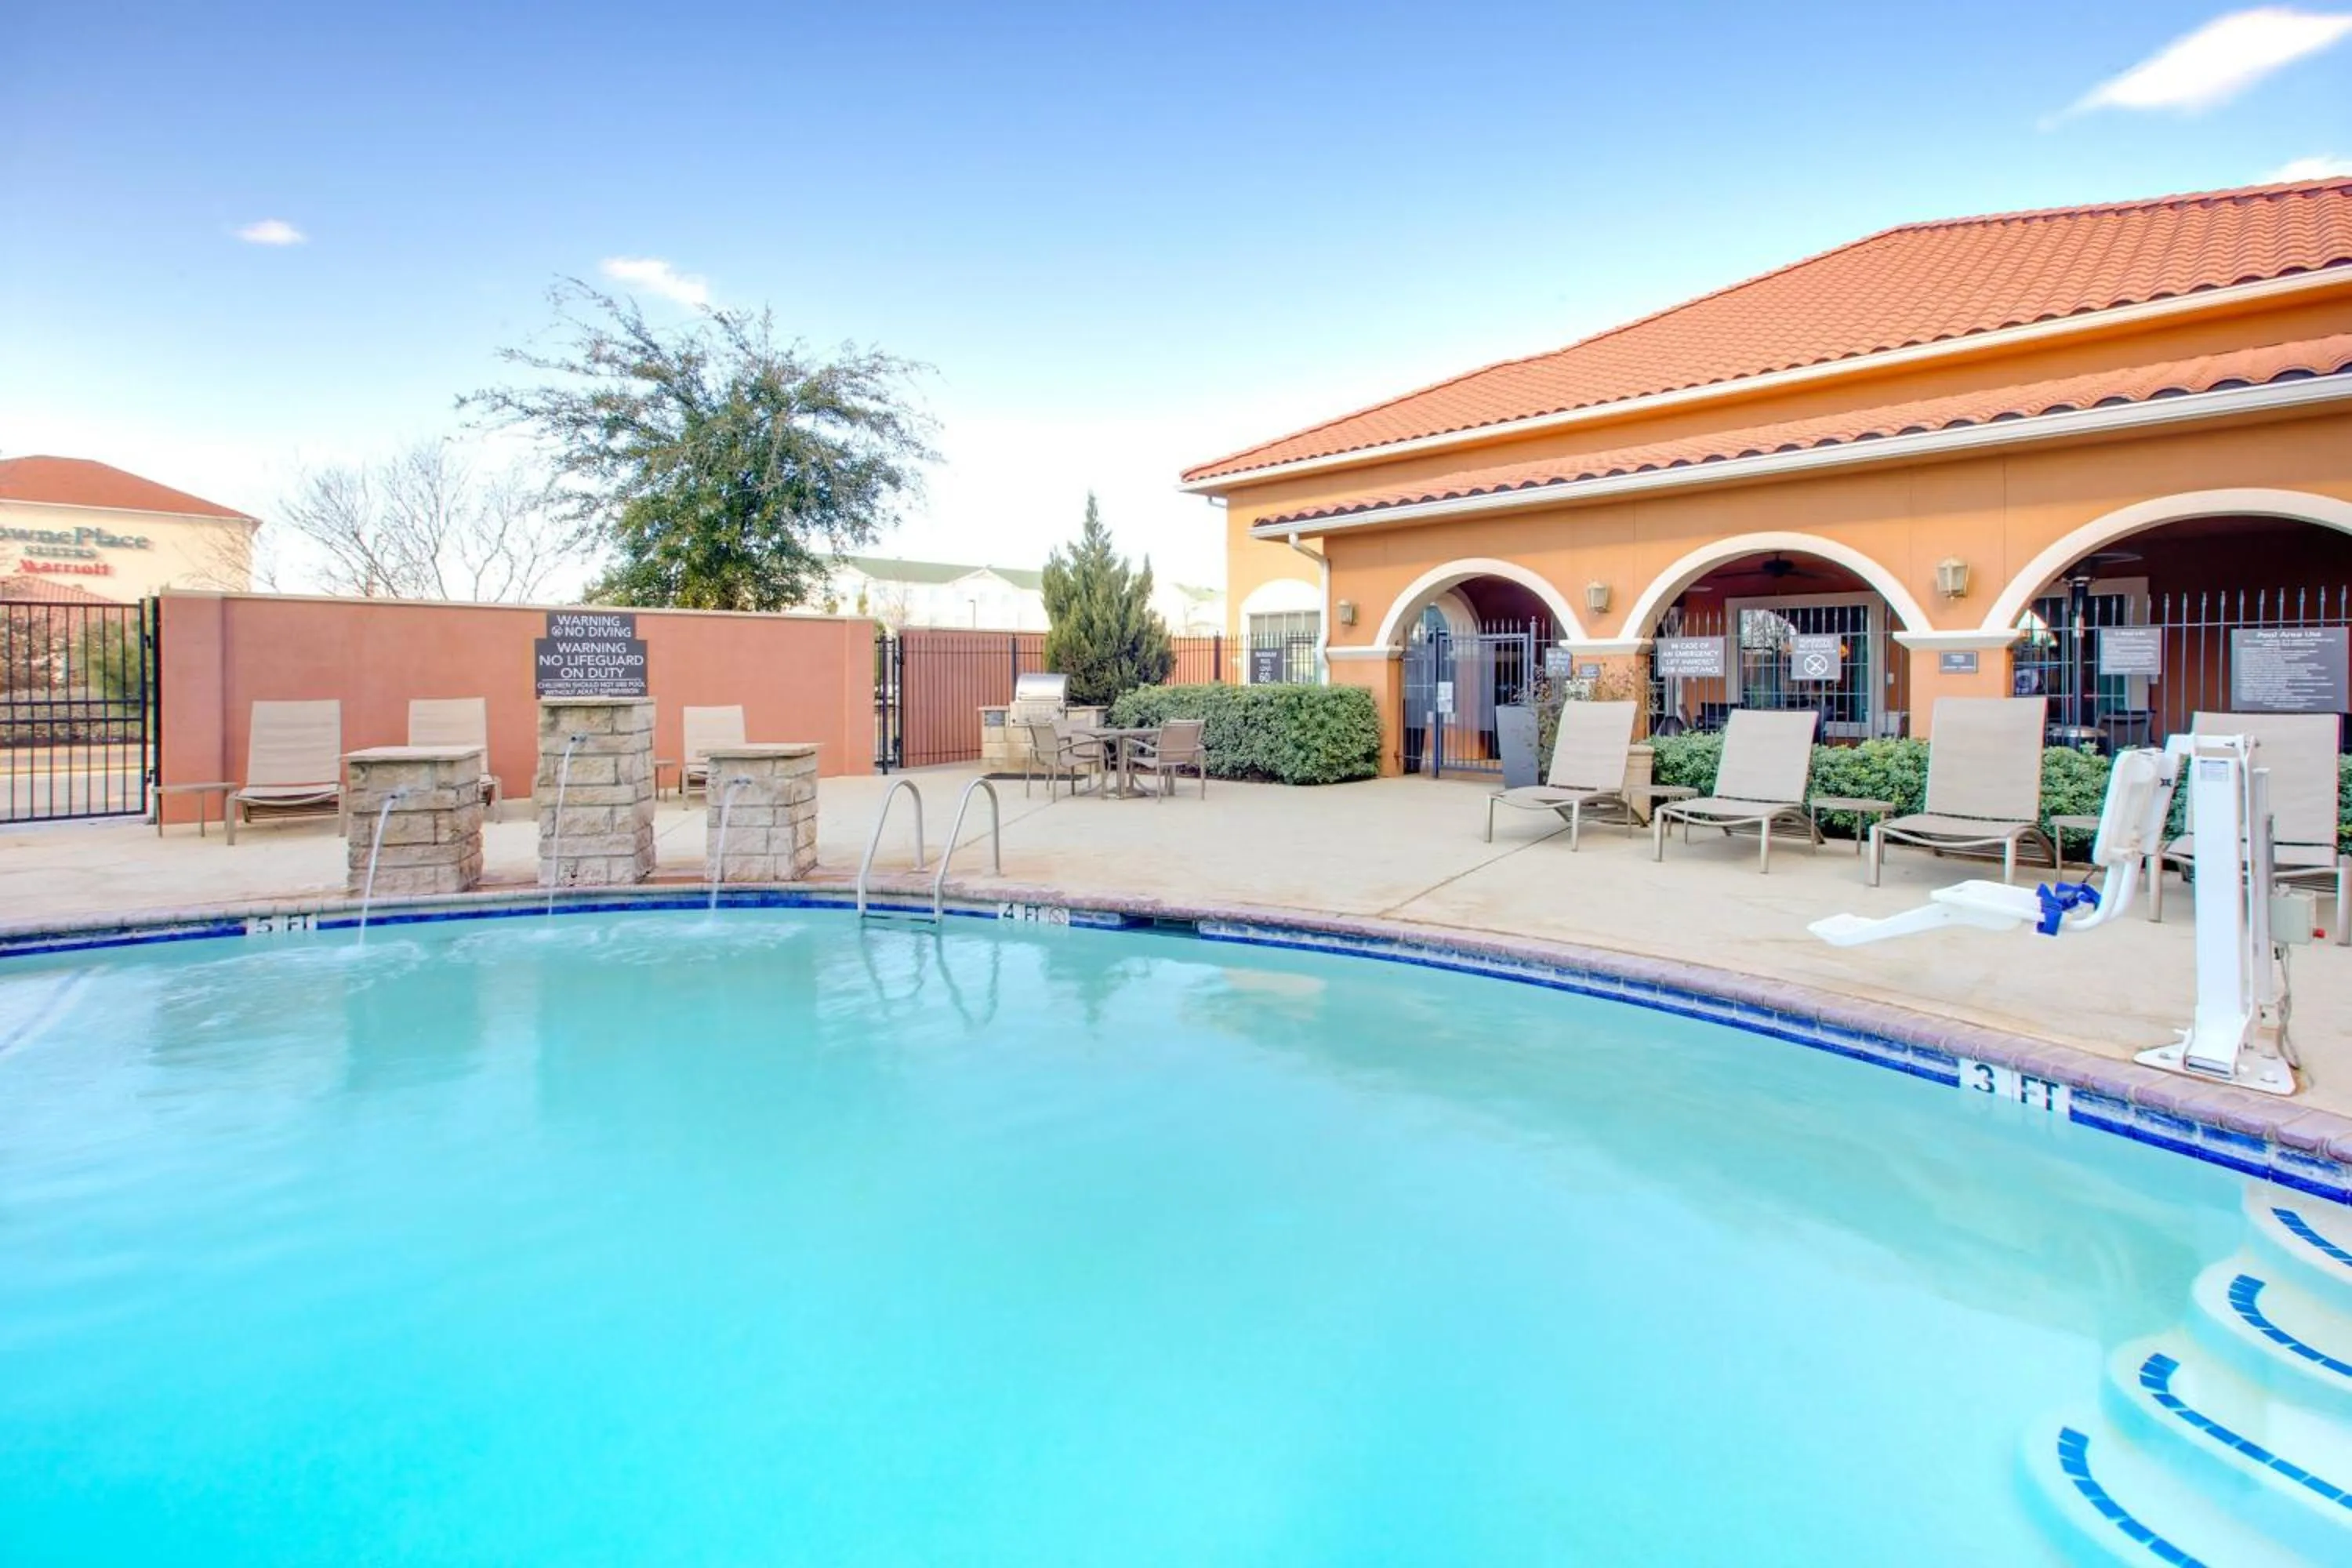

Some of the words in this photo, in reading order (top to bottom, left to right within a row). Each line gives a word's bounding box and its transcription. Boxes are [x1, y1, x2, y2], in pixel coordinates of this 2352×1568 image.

[13, 559, 111, 575] Marriott
[557, 615, 620, 626] WARNING
[564, 627, 585, 637] NO
[589, 627, 631, 637] DIVING
[557, 642, 626, 653] WARNING
[539, 655, 563, 666] NO
[567, 655, 644, 666] LIFEGUARD
[561, 667, 584, 678] ON
[589, 667, 625, 678] DUTY
[1003, 903, 1014, 919] 4
[1025, 904, 1041, 922] FT
[257, 915, 273, 933] 5
[1973, 1064, 1995, 1094] 3
[2021, 1075, 2059, 1111] FT
